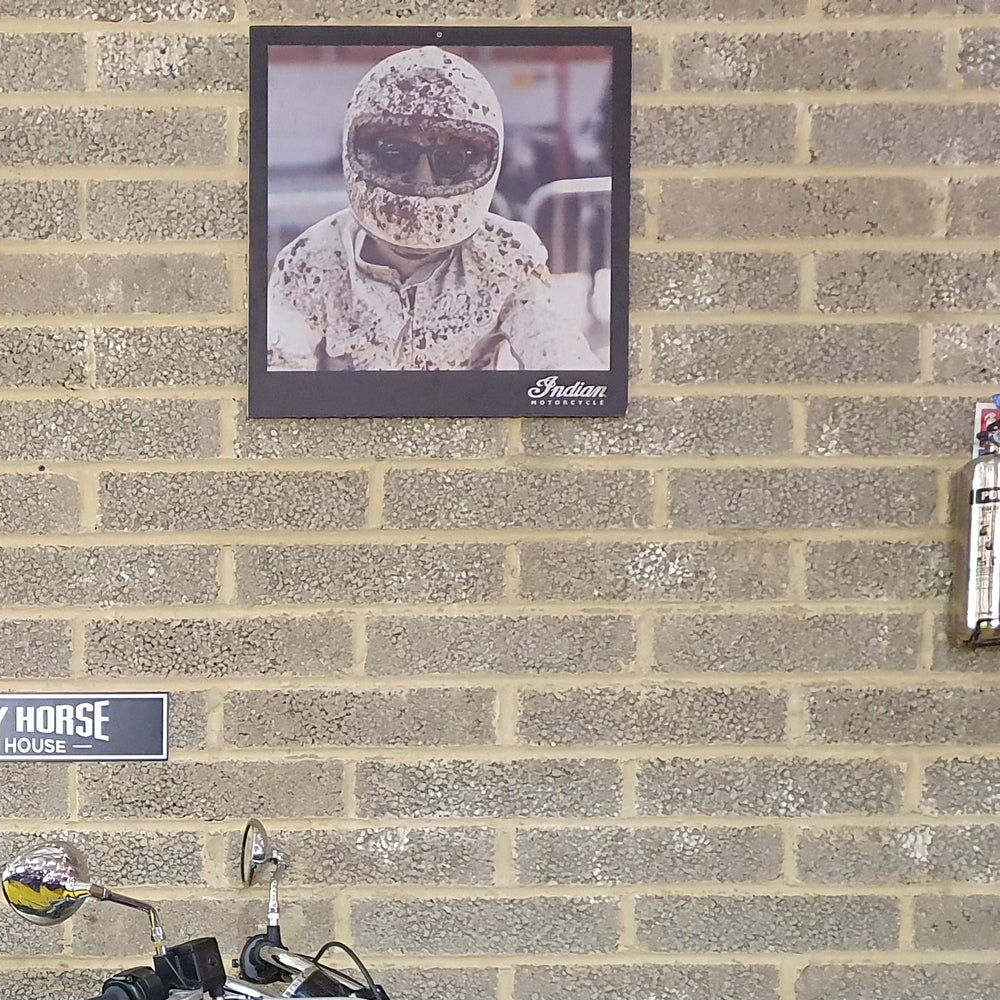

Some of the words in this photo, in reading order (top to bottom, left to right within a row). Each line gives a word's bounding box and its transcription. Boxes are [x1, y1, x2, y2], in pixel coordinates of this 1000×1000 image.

[527, 375, 608, 398] Indian
[16, 700, 110, 742] HORSE
[4, 738, 67, 754] HOUSE
